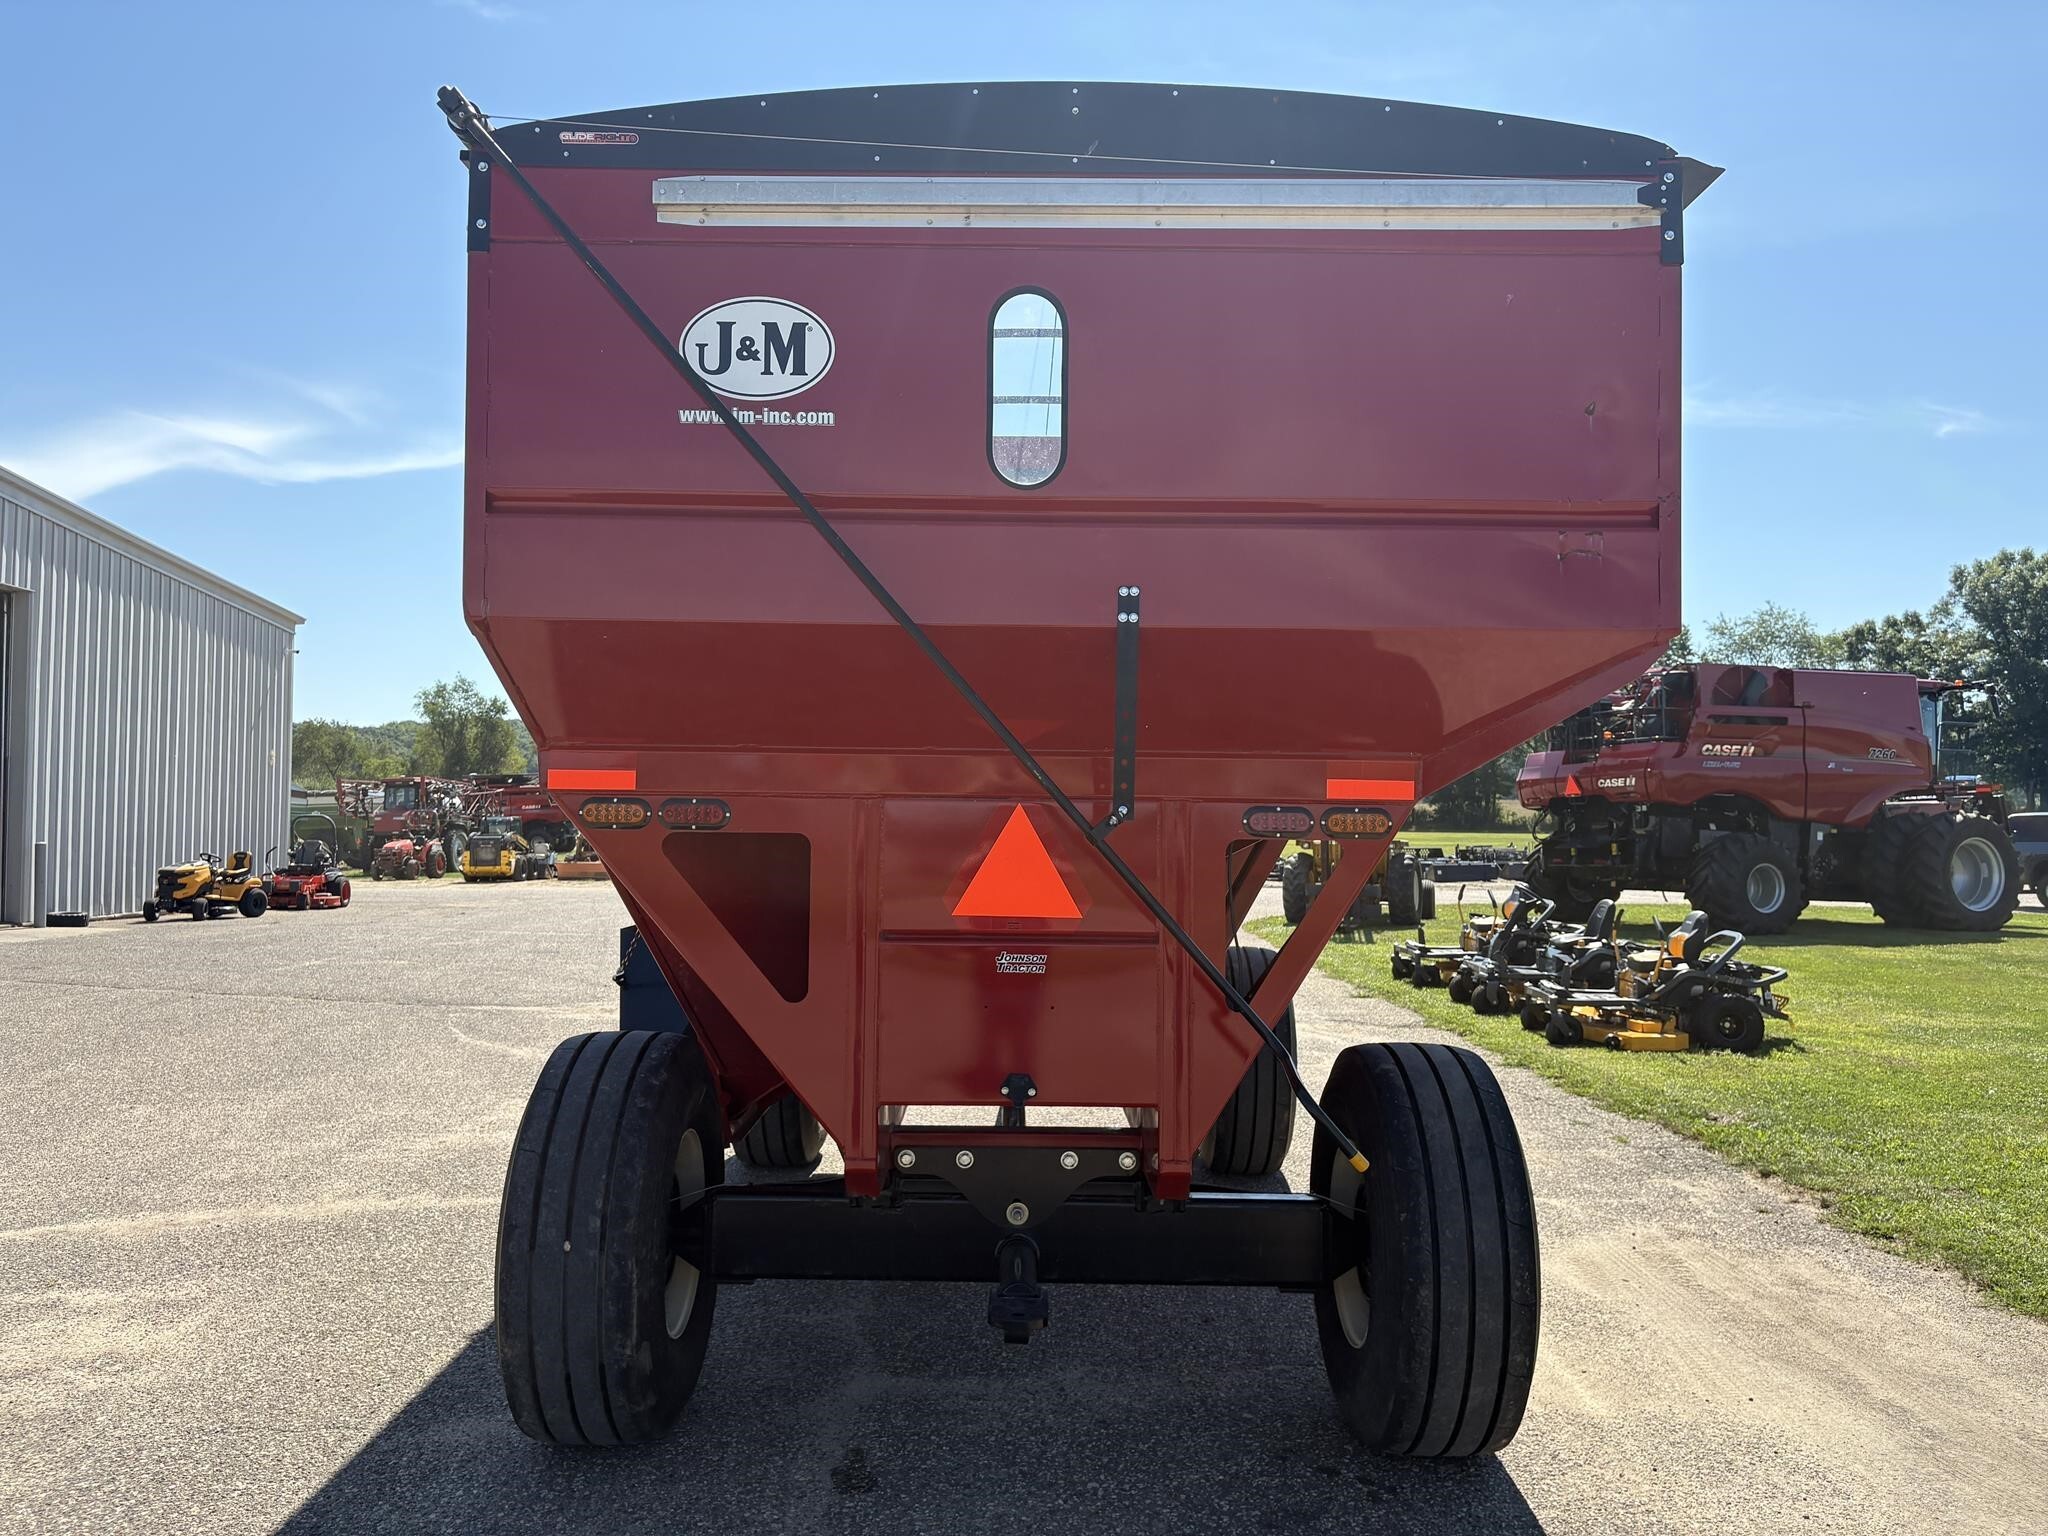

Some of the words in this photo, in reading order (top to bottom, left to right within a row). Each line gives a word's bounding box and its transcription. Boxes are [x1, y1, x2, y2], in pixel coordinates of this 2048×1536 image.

[679, 407, 835, 426] wwwm-inc.com
[1701, 744, 1741, 756] CASE
[1868, 747, 1897, 760] 7260
[1597, 778, 1625, 788] CASE
[995, 951, 1047, 963] JOHNSON
[997, 962, 1045, 973] TRACTOR
